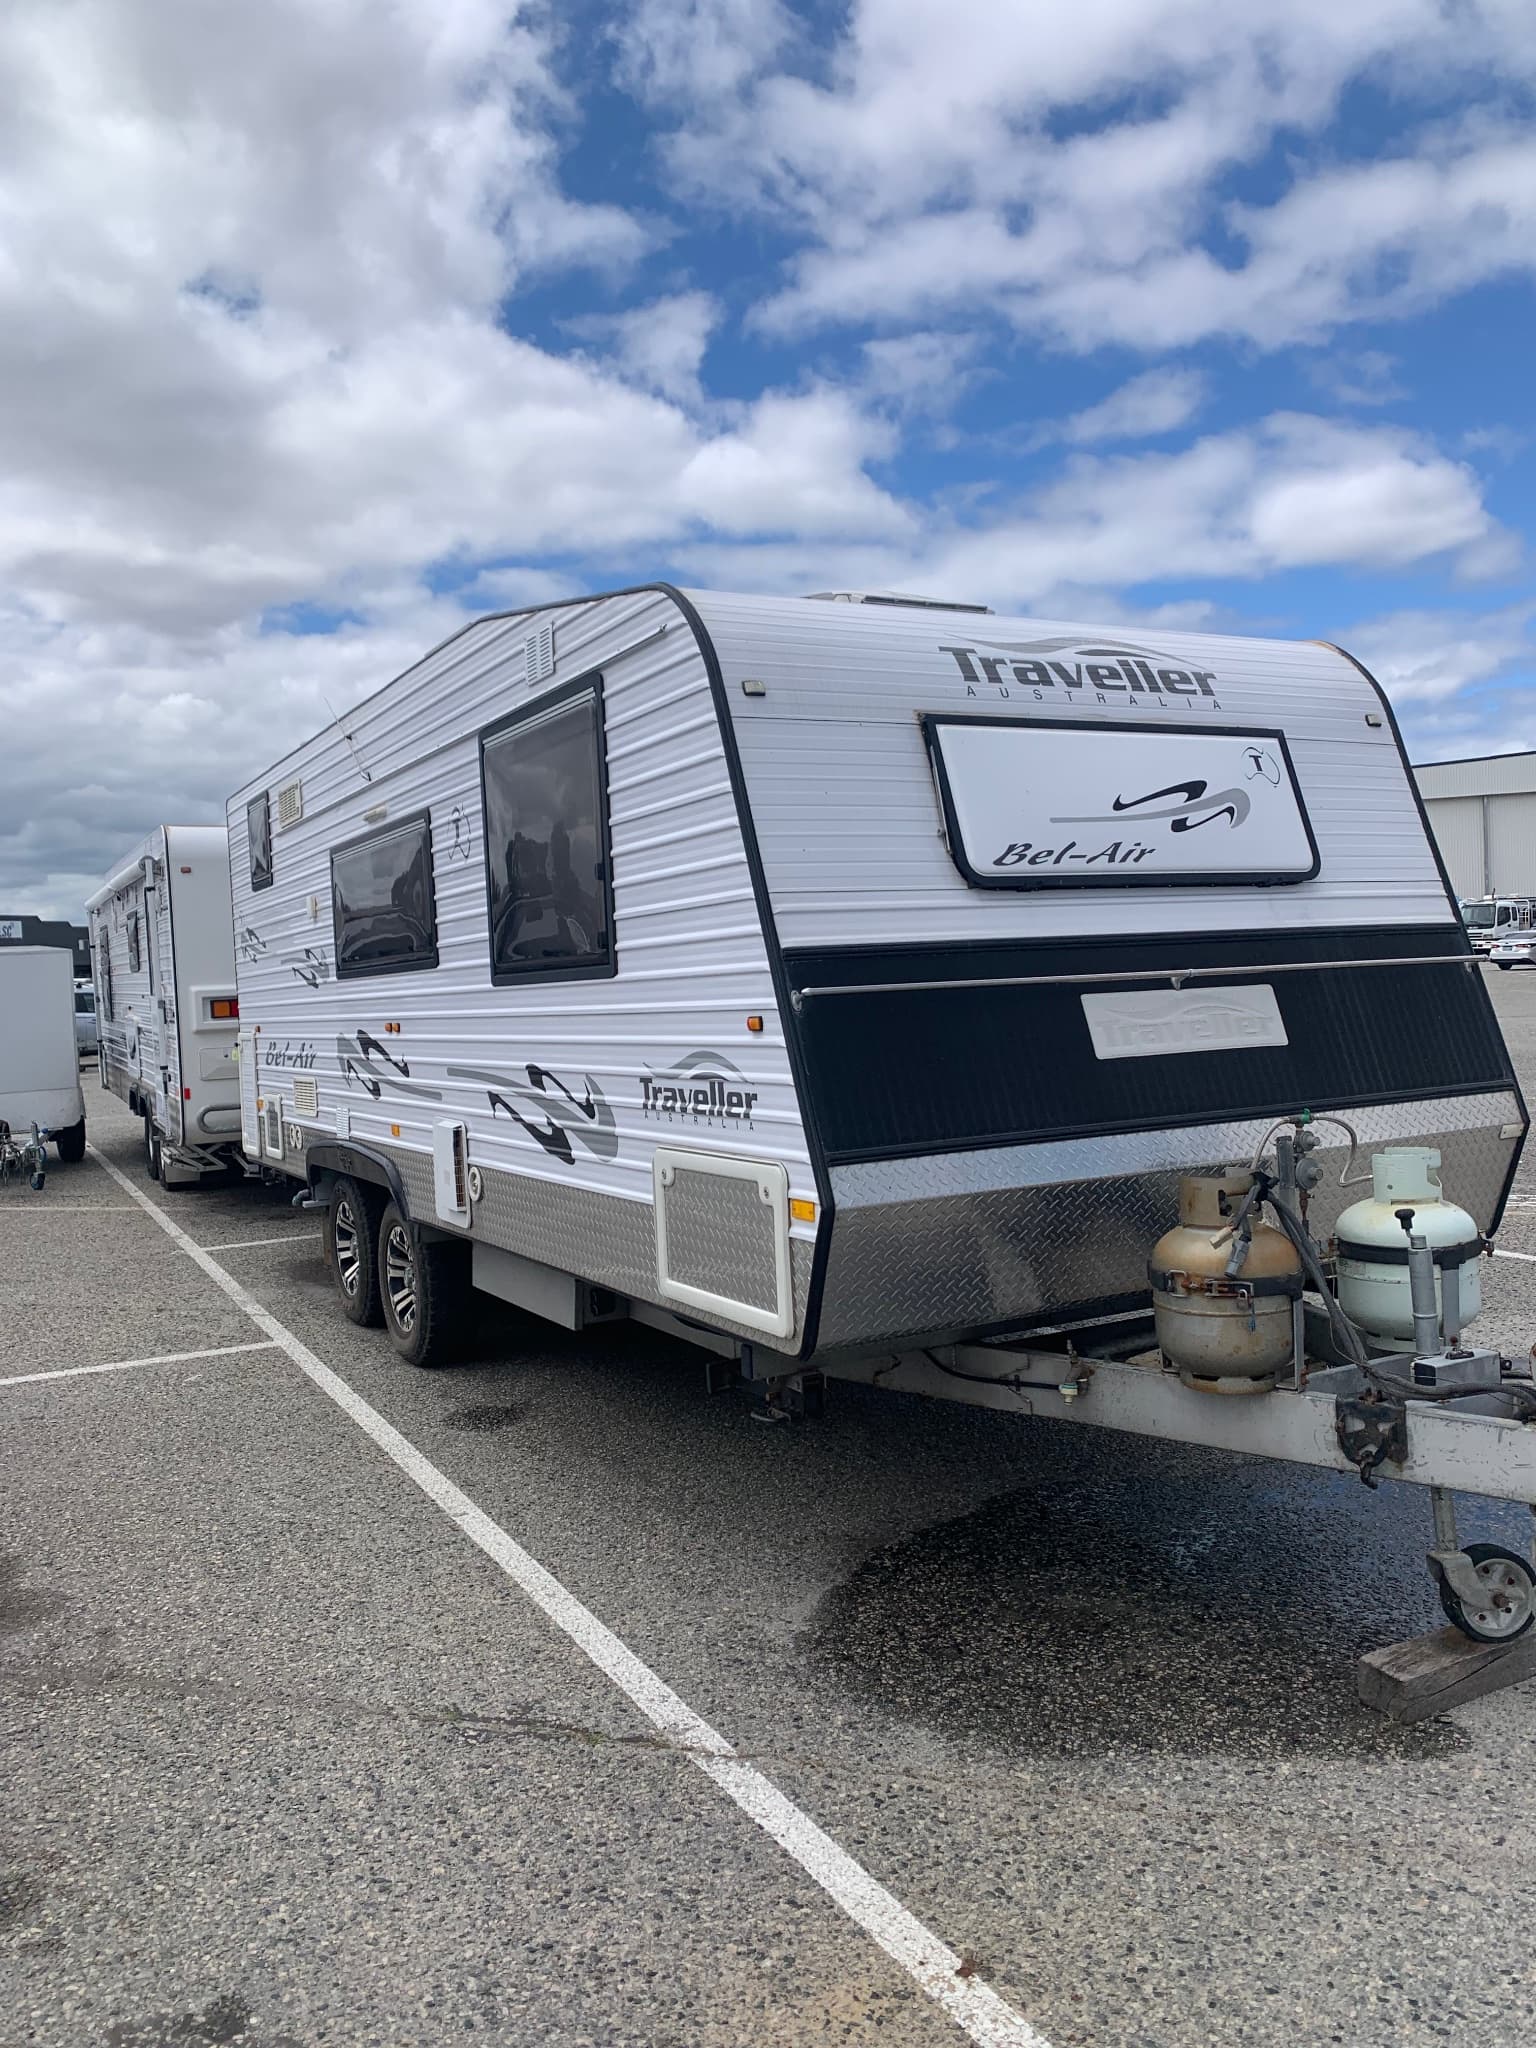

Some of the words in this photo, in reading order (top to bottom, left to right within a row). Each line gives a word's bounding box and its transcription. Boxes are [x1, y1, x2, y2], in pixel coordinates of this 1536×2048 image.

[938, 646, 1217, 697] Traveller
[966, 686, 1222, 710] AUSTRALIA
[993, 841, 1156, 867] Bel-Air
[266, 1041, 316, 1069] Bel-Air
[640, 1078, 757, 1119] Traveller
[645, 1112, 754, 1131] AUSTRALIA
